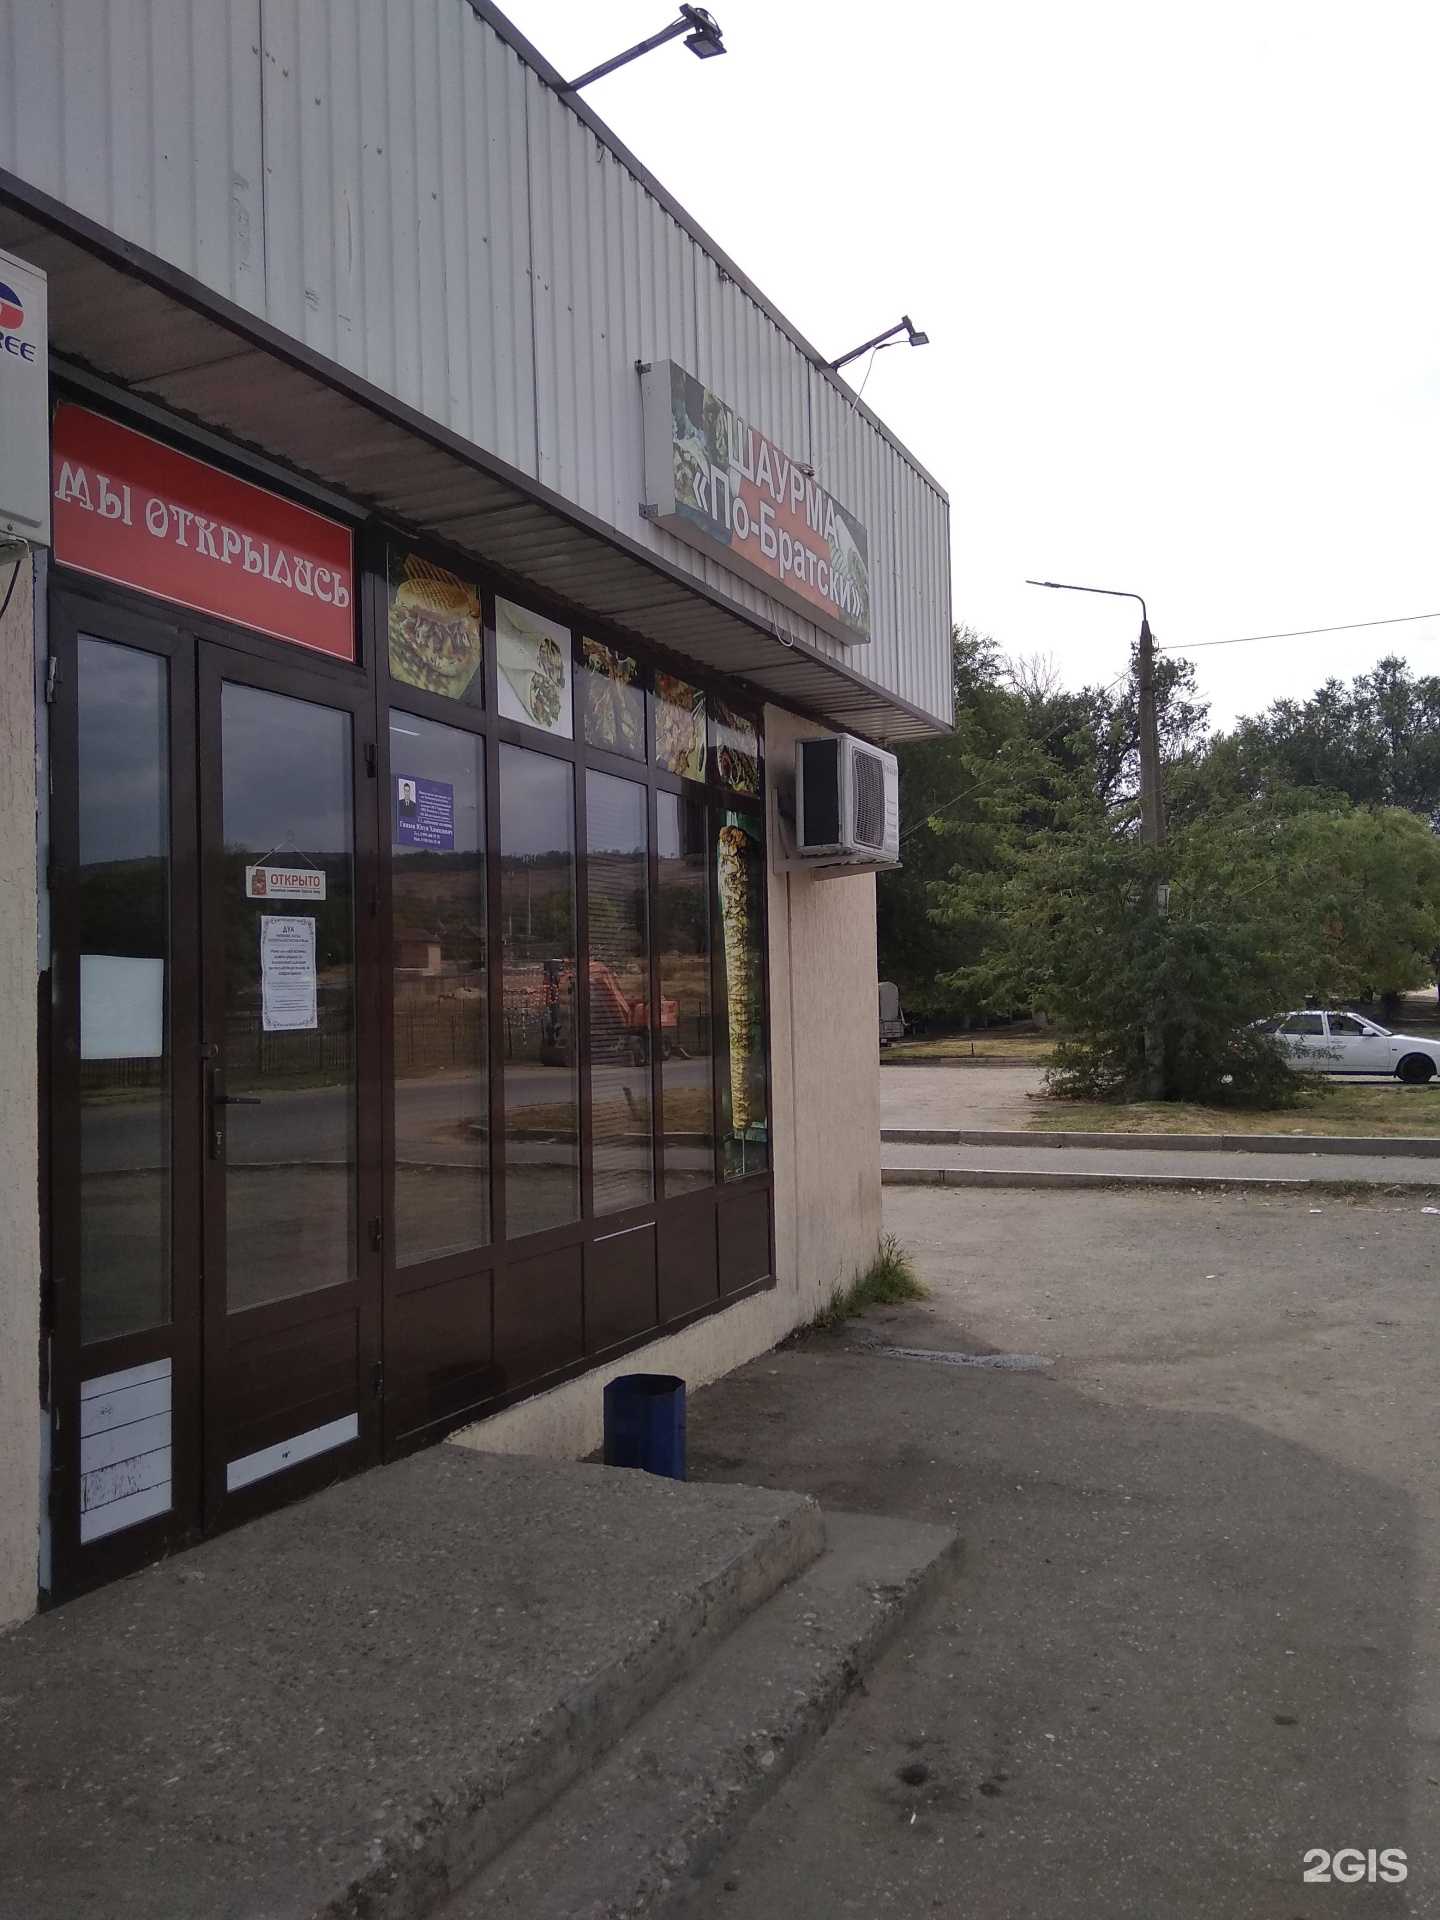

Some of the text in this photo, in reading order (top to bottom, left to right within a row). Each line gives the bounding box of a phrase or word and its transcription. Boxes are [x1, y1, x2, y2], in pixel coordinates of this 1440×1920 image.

[0, 331, 36, 362] EE
[727, 410, 839, 547] ШАУРМА
[54, 461, 350, 609] МЫ ОТКРЫЛИСЬ
[270, 873, 321, 887] ОТКРЫТО
